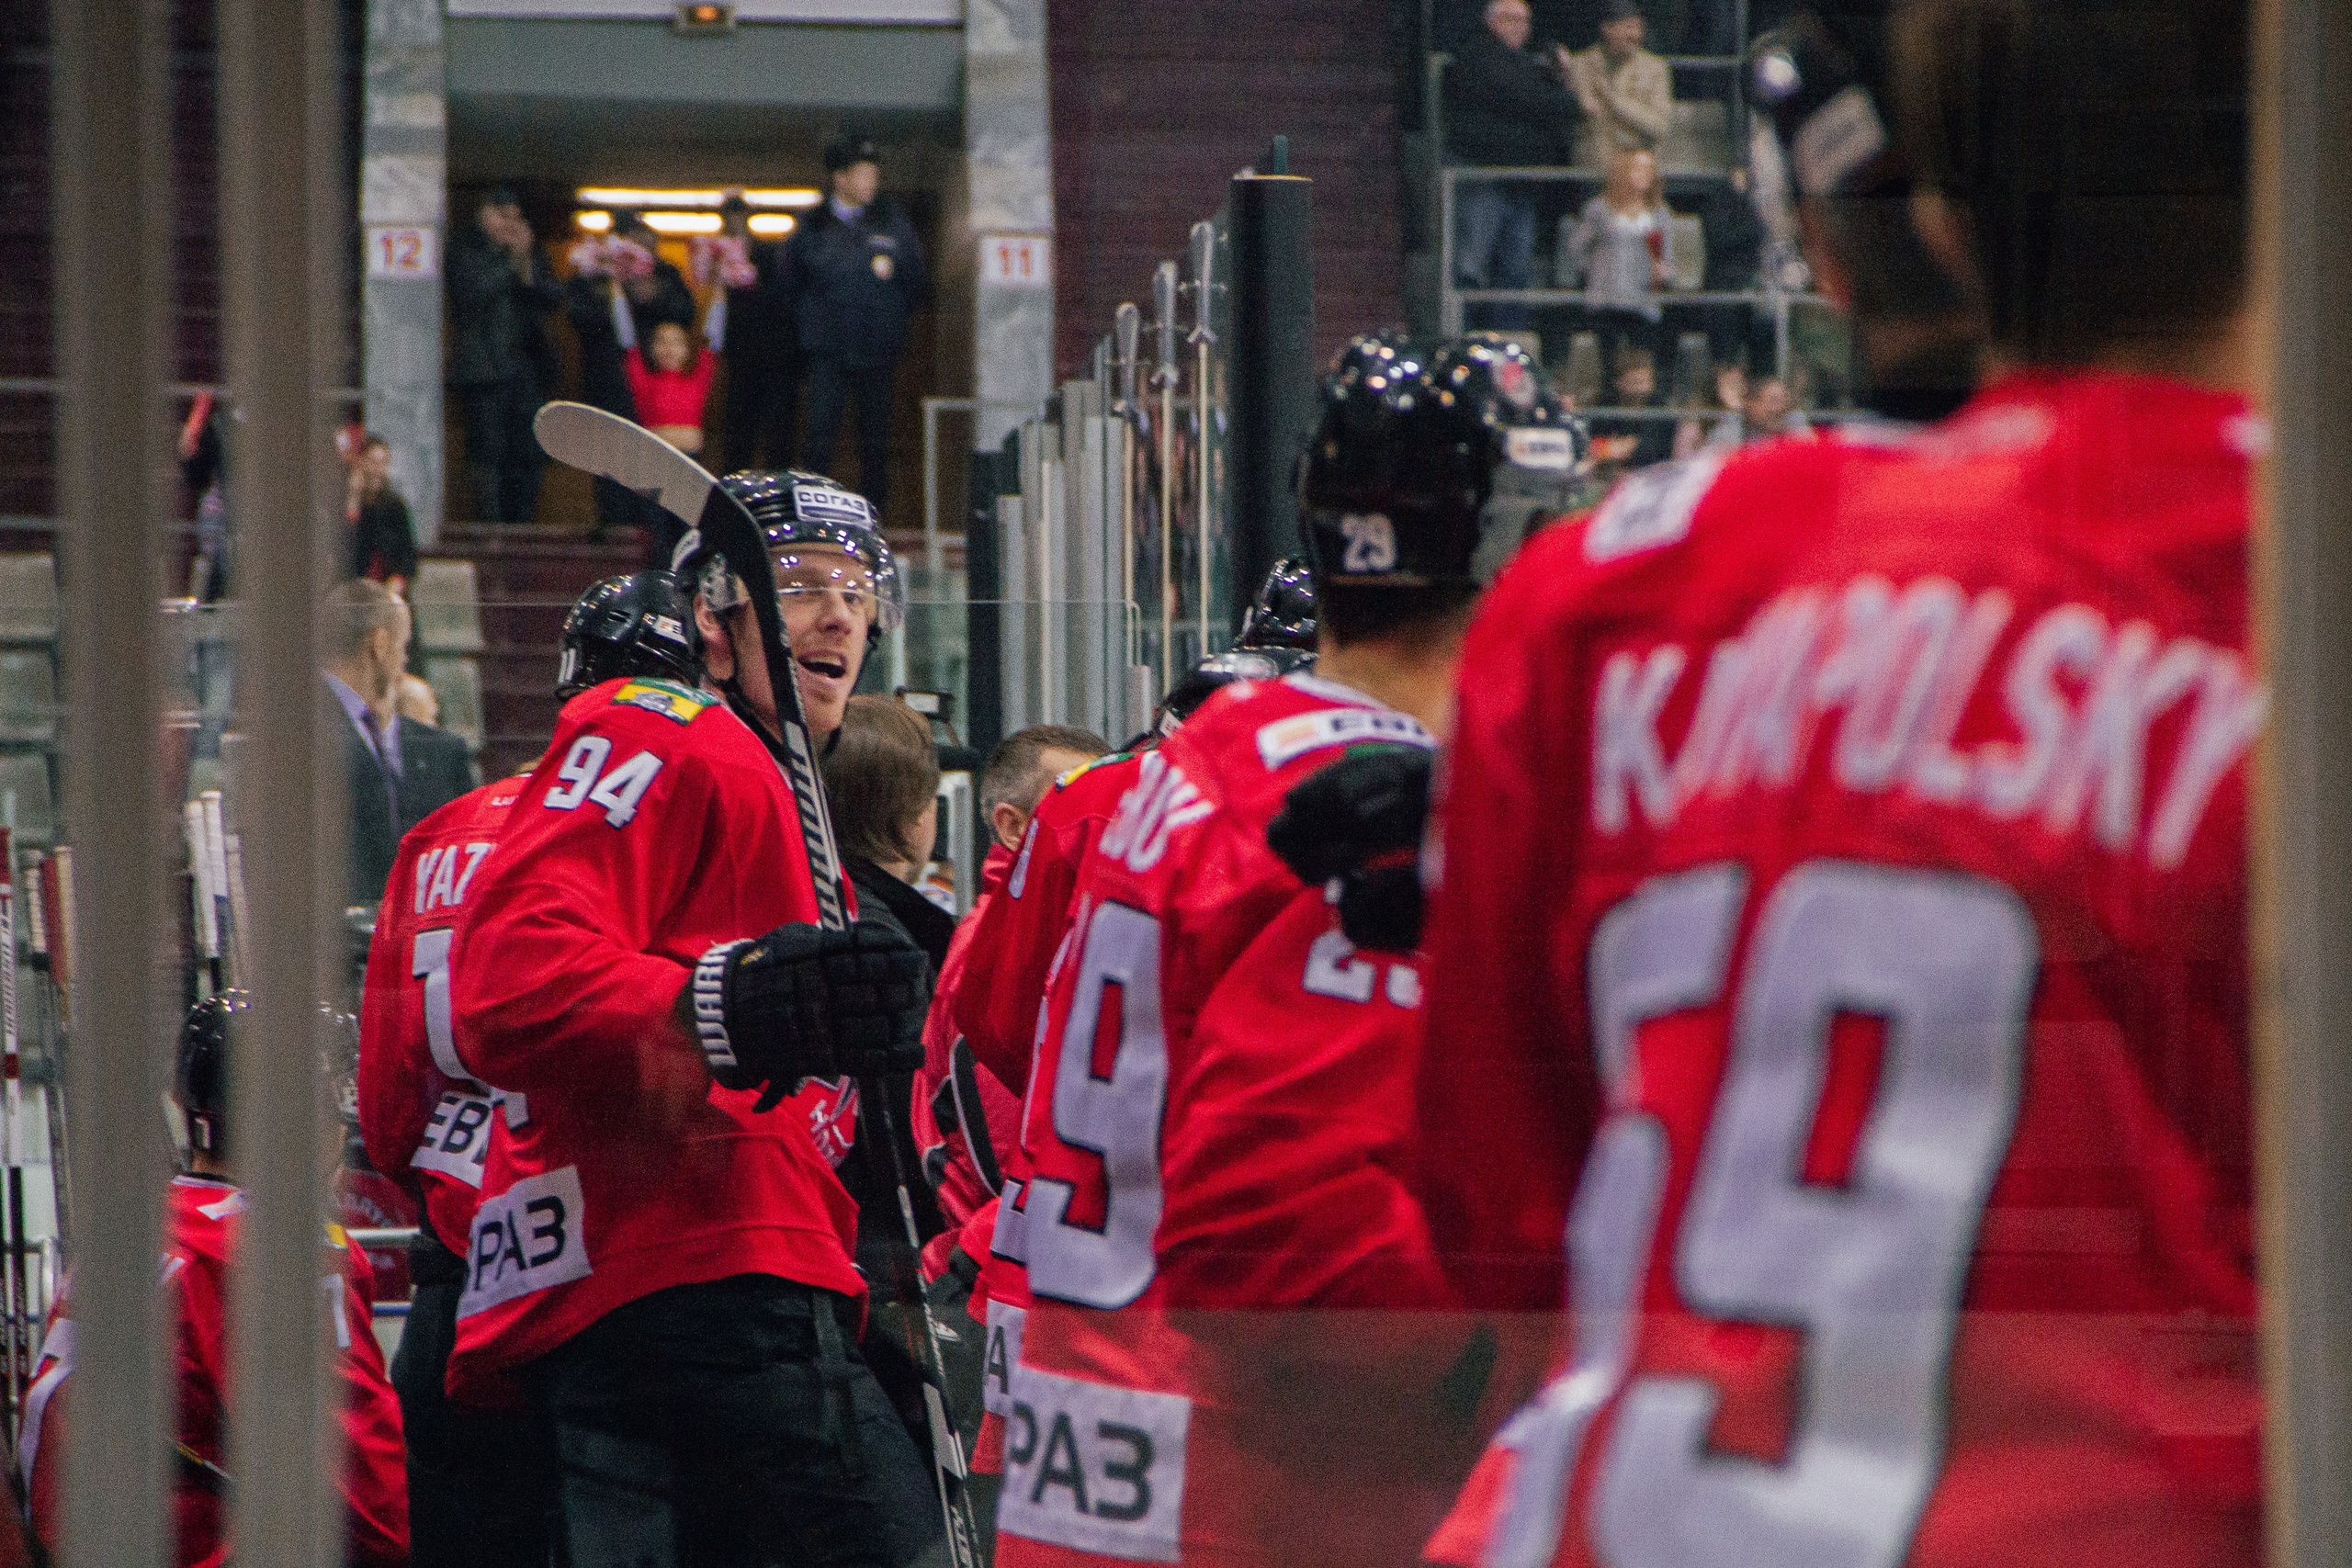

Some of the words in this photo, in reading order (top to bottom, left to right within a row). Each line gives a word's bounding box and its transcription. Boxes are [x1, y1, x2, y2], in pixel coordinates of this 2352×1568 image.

[379, 231, 424, 269] 12
[996, 243, 1033, 276] 11
[797, 491, 865, 513] СОГАЗ
[543, 735, 663, 830] 94
[474, 1195, 567, 1291] РАЗ
